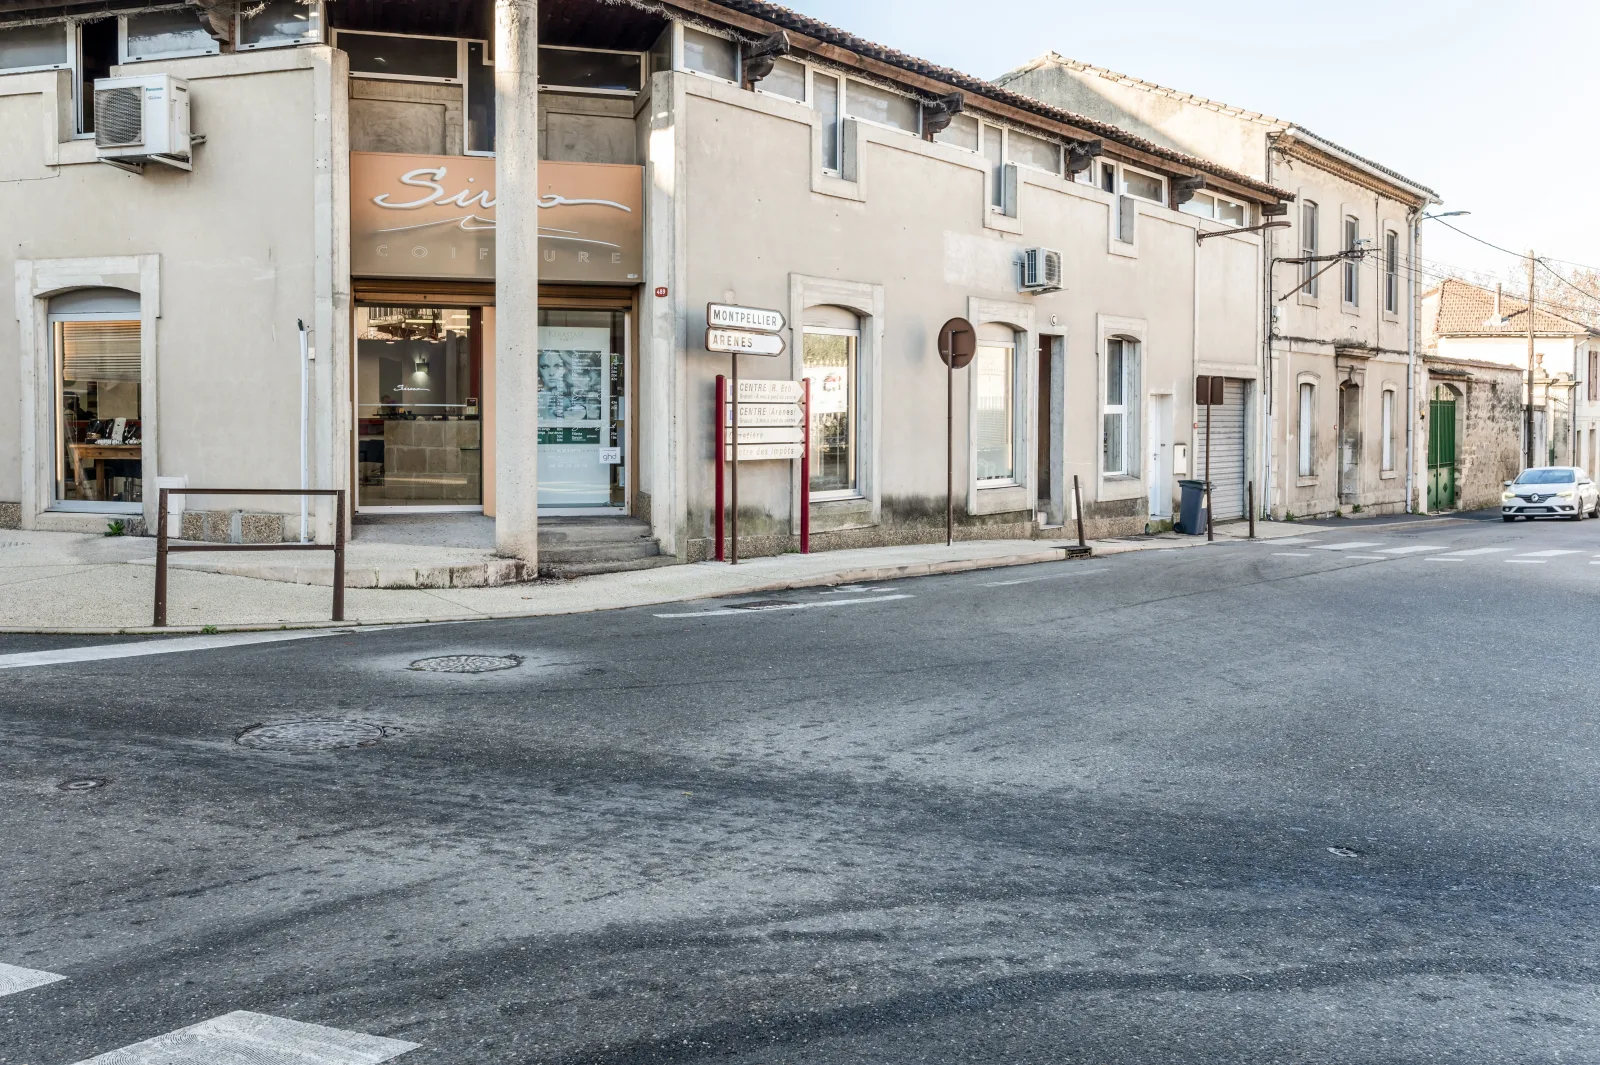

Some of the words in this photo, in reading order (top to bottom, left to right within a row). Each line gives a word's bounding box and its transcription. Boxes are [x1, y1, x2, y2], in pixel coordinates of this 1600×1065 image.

[373, 166, 632, 212] Sira
[375, 244, 622, 264] COIFURE
[713, 309, 777, 327] MONTPELLIER
[712, 334, 753, 348] ARENES
[739, 383, 767, 392] CENTRE
[739, 407, 767, 416] CENTRE
[602, 451, 617, 462] ghd
[756, 447, 768, 455] des
